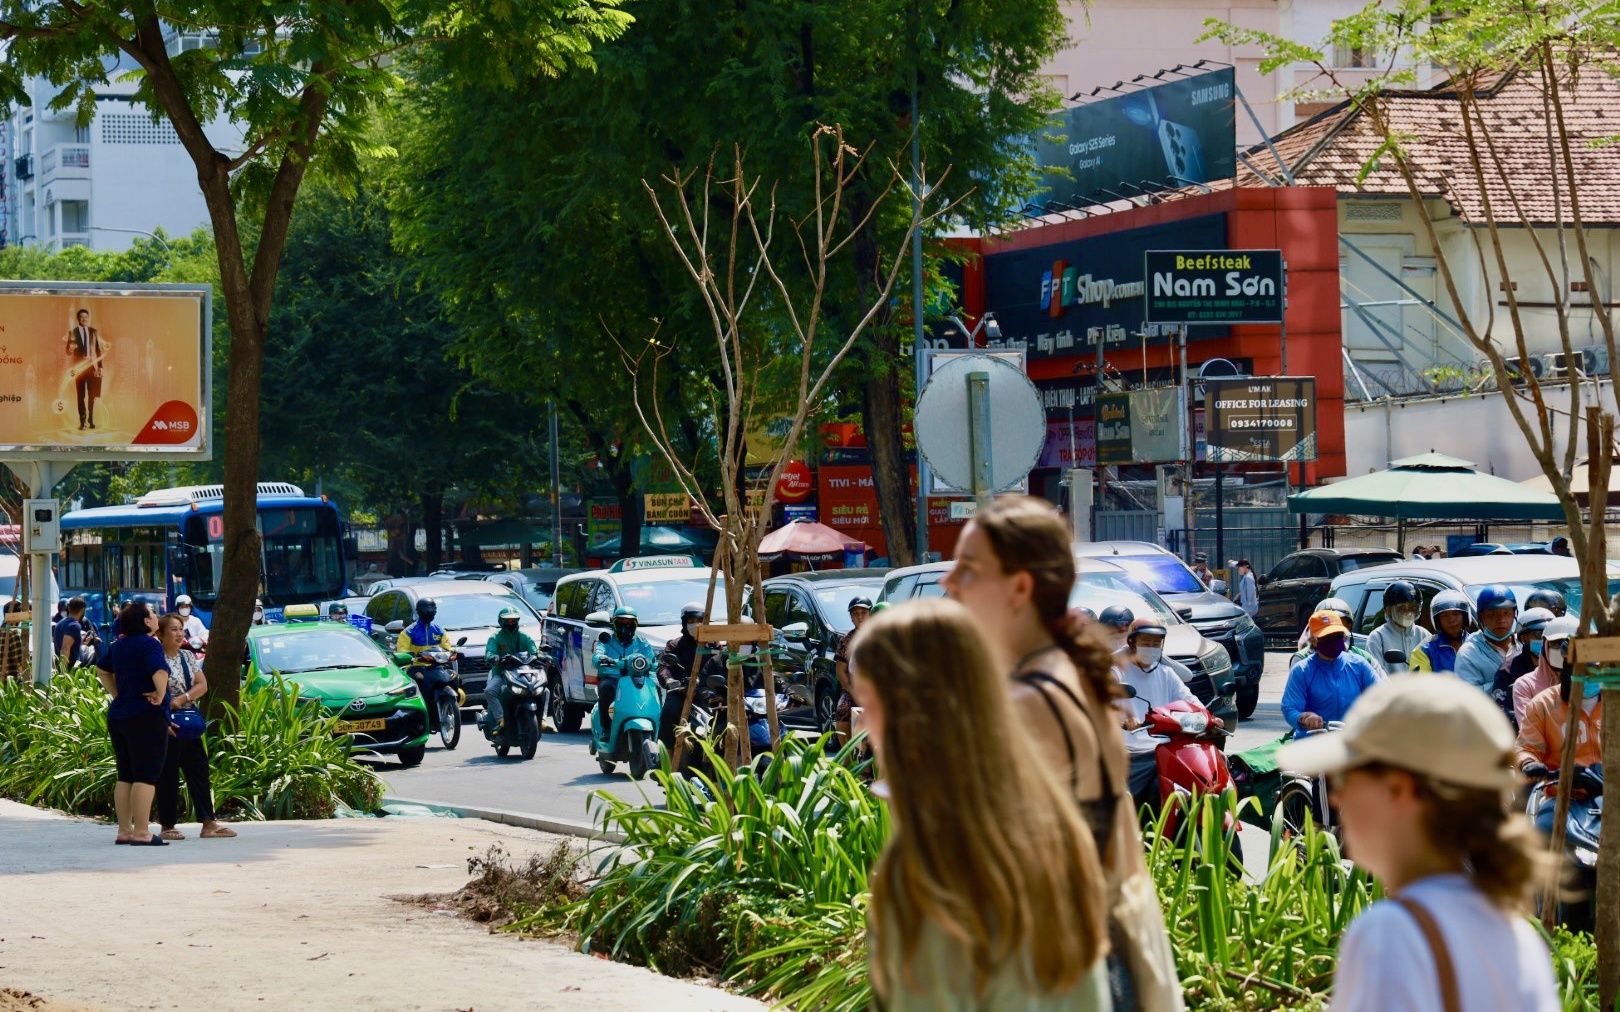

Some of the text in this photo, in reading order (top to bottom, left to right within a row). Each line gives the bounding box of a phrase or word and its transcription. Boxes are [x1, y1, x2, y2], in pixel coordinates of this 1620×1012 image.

[1191, 83, 1229, 106] SAMSUNG
[1069, 133, 1116, 156] Galaxy S25 Series
[1079, 156, 1096, 170] Galaxy
[1176, 255, 1251, 270] Beefsteak
[1153, 271, 1275, 297] Nam Sơn
[1215, 398, 1308, 409] OFFICE FOR LEASING
[168, 421, 190, 430] MSB
[1231, 419, 1293, 428] 0934170008
[828, 478, 849, 487] TIVI
[832, 503, 869, 515] SIÊU RẺ
[832, 516, 869, 525] SIÊU MỚI
